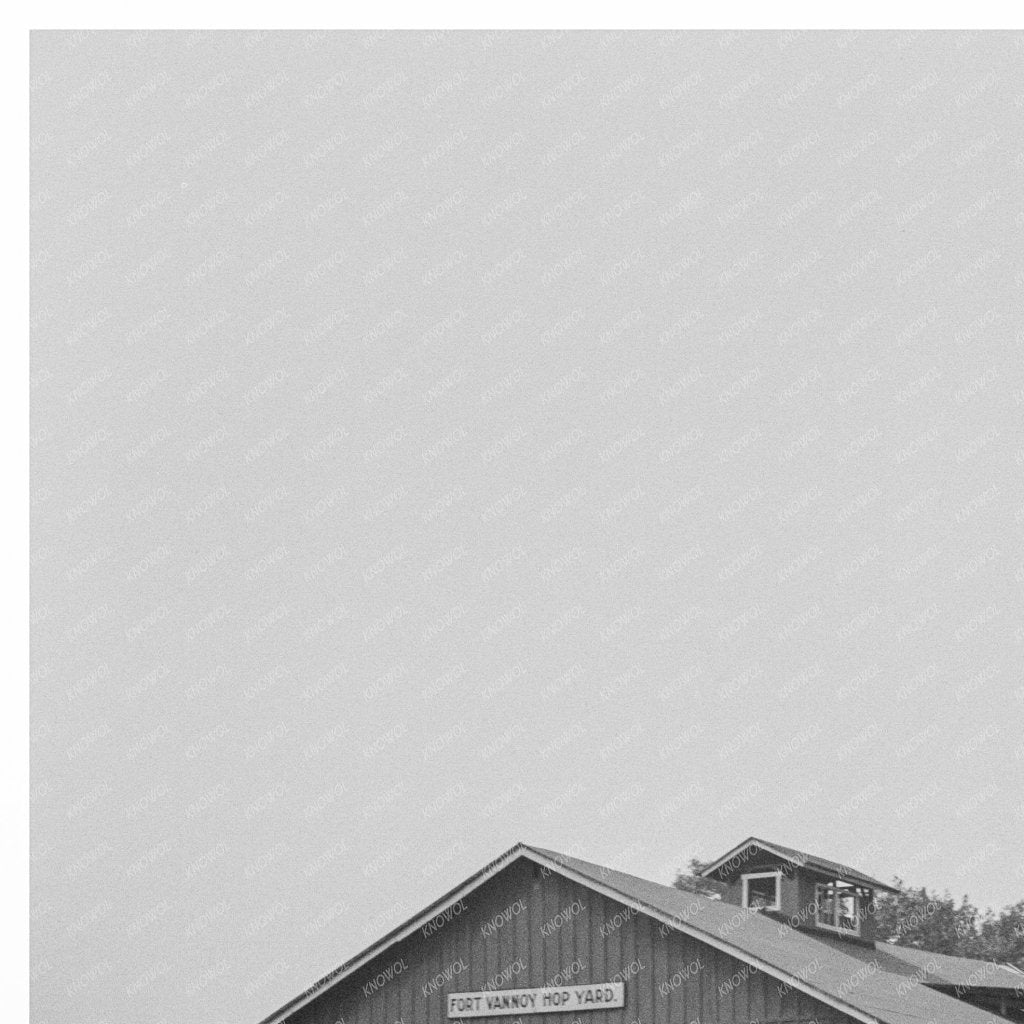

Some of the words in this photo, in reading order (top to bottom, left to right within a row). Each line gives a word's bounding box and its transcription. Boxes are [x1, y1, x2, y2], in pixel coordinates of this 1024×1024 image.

[449, 996, 482, 1013] FORT
[485, 992, 537, 1010] VANNOY
[542, 990, 570, 1007] HOP
